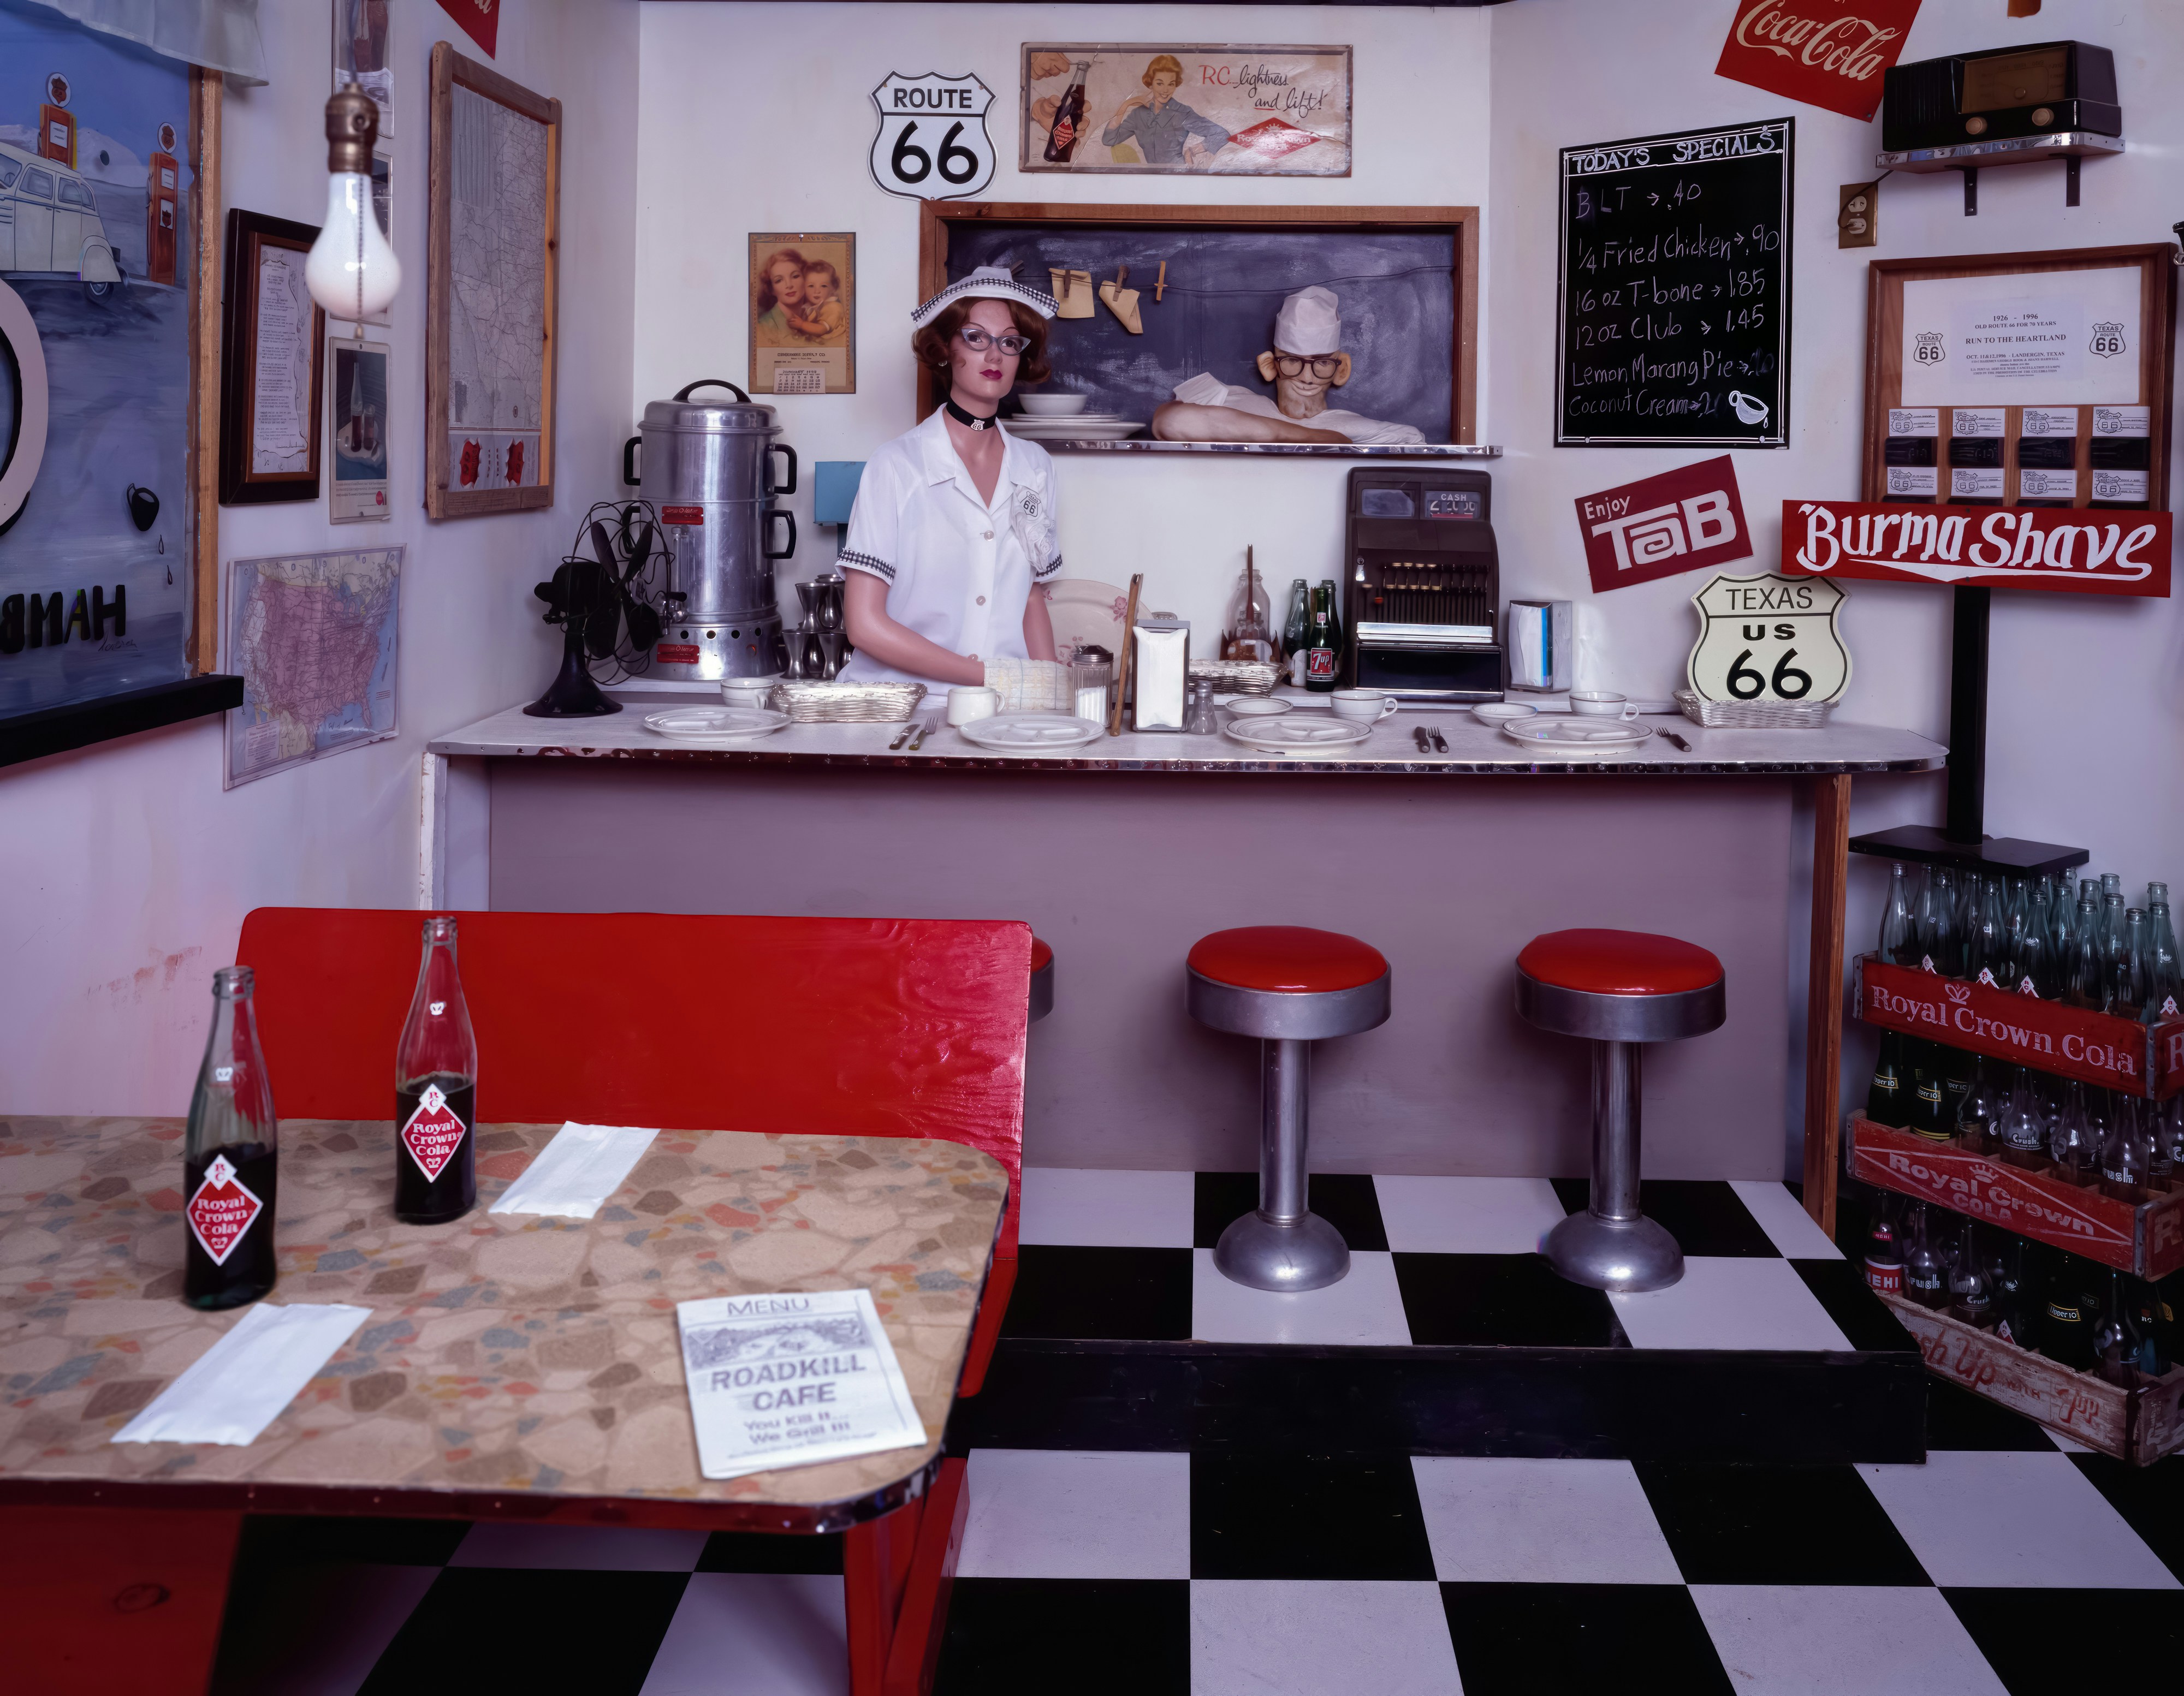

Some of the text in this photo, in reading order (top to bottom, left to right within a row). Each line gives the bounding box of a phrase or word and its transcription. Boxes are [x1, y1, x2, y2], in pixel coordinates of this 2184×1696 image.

[1736, 0, 1903, 81] Coca-Cola
[1233, 64, 1289, 97] lightness
[894, 88, 972, 109] ROUTE
[1254, 87, 1325, 118] and lift!
[892, 120, 978, 184] 66
[1572, 132, 1776, 174] TODAY'S SPECIALS
[1603, 235, 1658, 268] Fried
[1664, 223, 1731, 261] Chicken
[1576, 289, 1595, 316] 16
[1626, 276, 1704, 307] T-bone
[1576, 325, 1595, 350] 12
[1631, 312, 1682, 341] Club
[2015, 334, 2067, 342] HEARTLAND
[1919, 346, 1939, 360] 66
[2096, 337, 2118, 352] 66
[1573, 362, 1628, 386] Lemon
[1702, 349, 1734, 380] Pie
[1569, 388, 1633, 416] Coconut
[1636, 389, 1689, 416] Cream
[1024, 500, 1036, 514] 66
[1584, 496, 1630, 520] Enjoy
[1796, 503, 2157, 580] Burma Shave
[1725, 586, 1813, 611] TEXAS
[1742, 623, 1796, 641] US
[1726, 647, 1813, 700] 66
[1871, 985, 2137, 1076] Royal Crown Cola
[411, 1132, 457, 1145] Crown
[413, 1120, 455, 1134] Royal
[416, 1144, 450, 1156] Cola
[2102, 1167, 2134, 1184] rush
[197, 1195, 245, 1212] Royal
[1889, 1153, 2094, 1236] Royal Crown
[1953, 1193, 2013, 1221] COLA
[194, 1210, 247, 1224] Crown
[200, 1221, 239, 1235] Cola
[1909, 1274, 1940, 1290] rush
[728, 1298, 810, 1316] MENU
[711, 1354, 866, 1392] ROADKILL
[752, 1382, 837, 1412] CAFE
